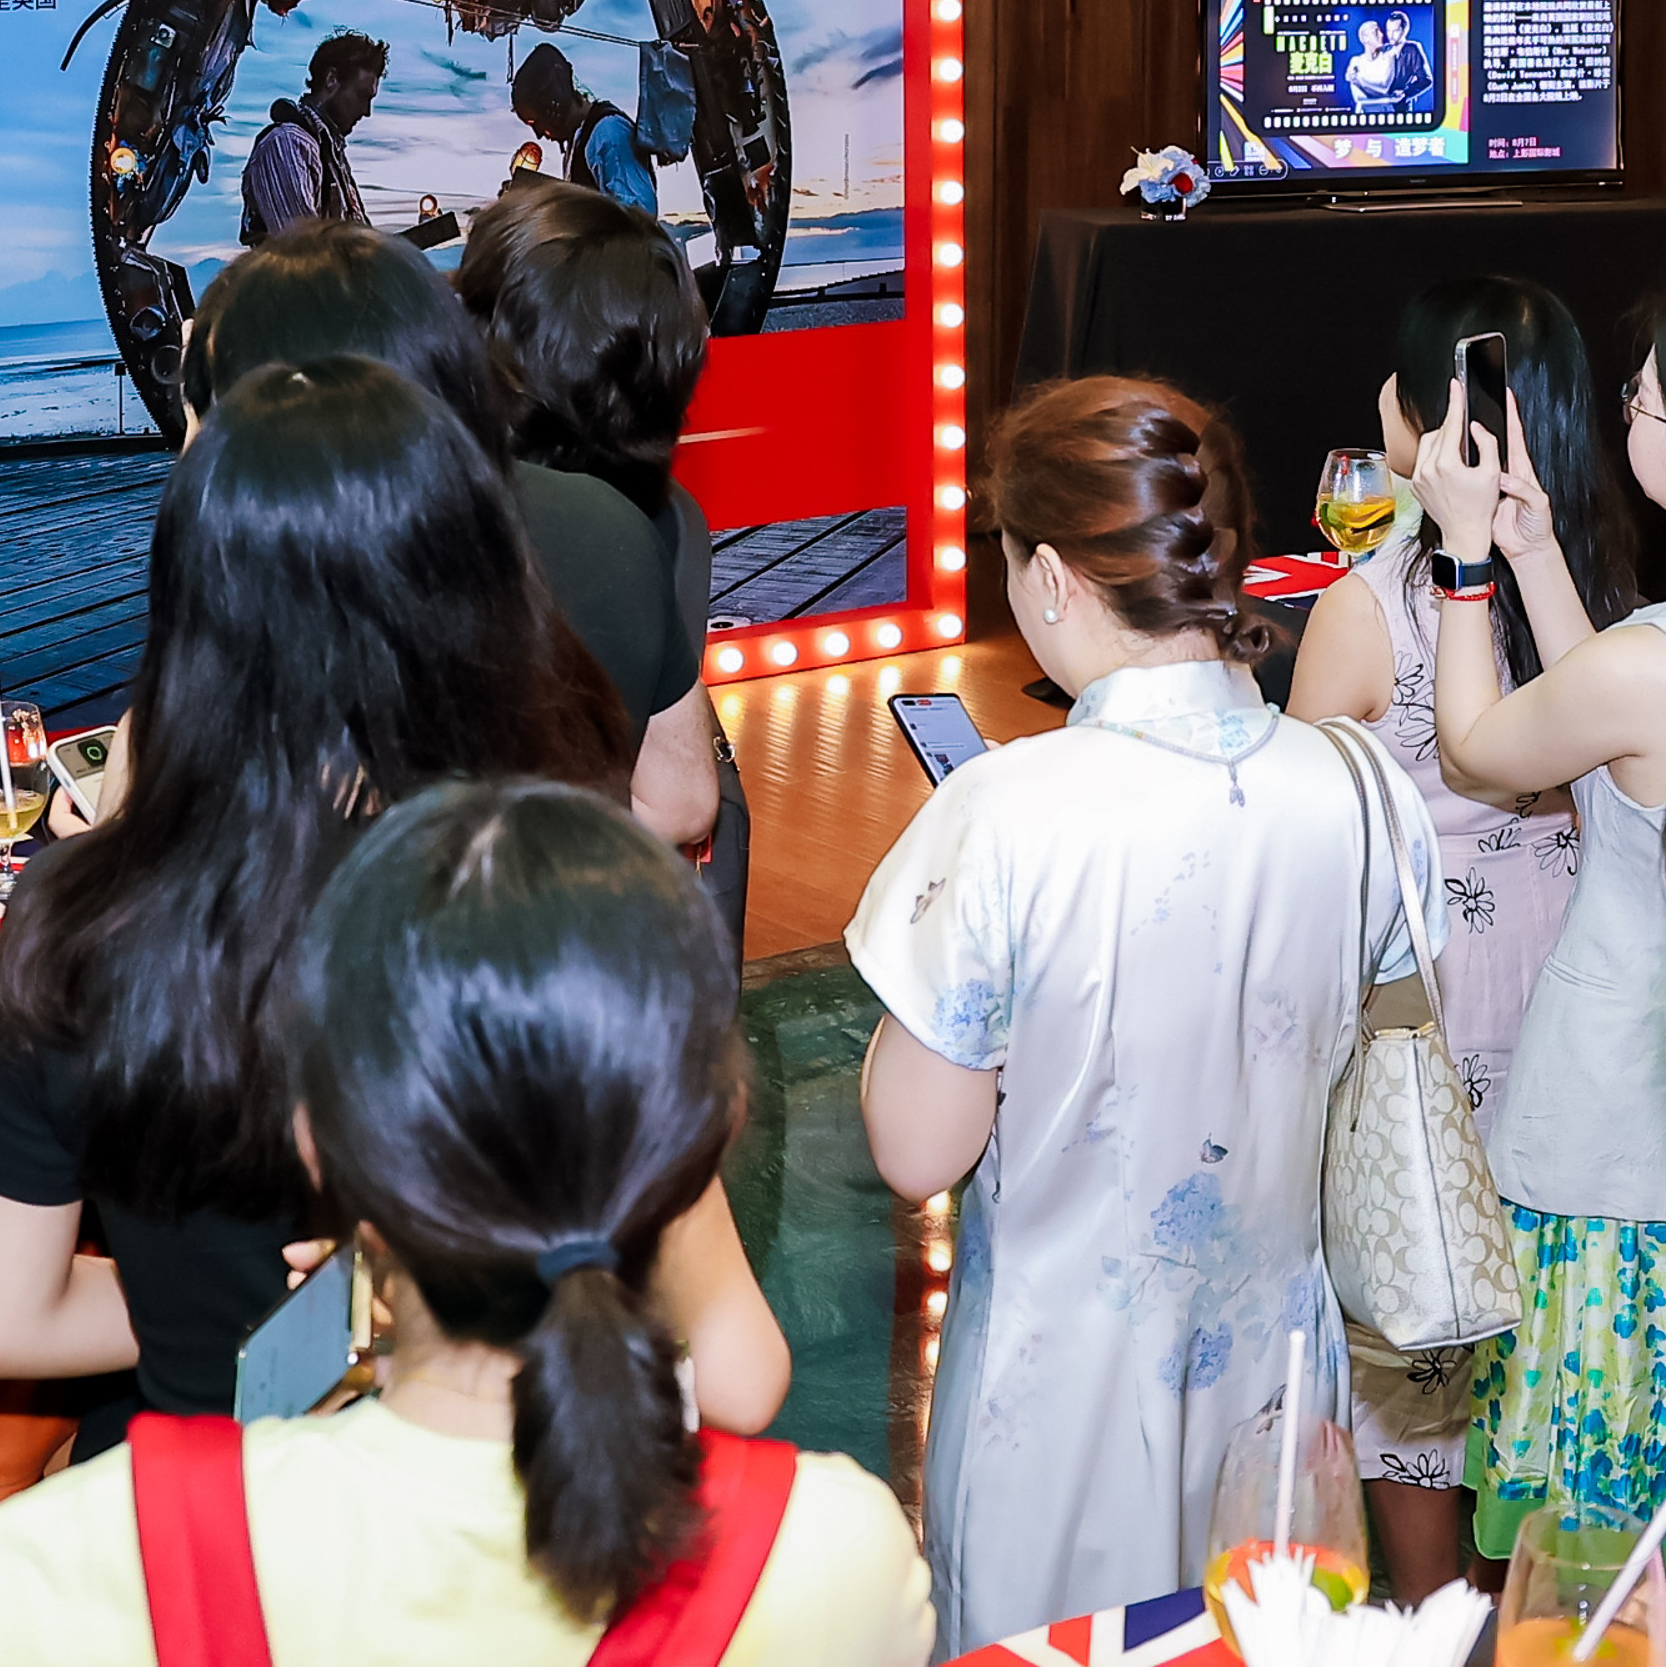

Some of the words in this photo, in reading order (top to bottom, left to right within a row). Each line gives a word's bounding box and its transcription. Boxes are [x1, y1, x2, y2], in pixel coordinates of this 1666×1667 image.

[1290, 51, 1333, 75] 麦克白
[1334, 138, 1353, 159] 梦
[1365, 139, 1383, 158] 与
